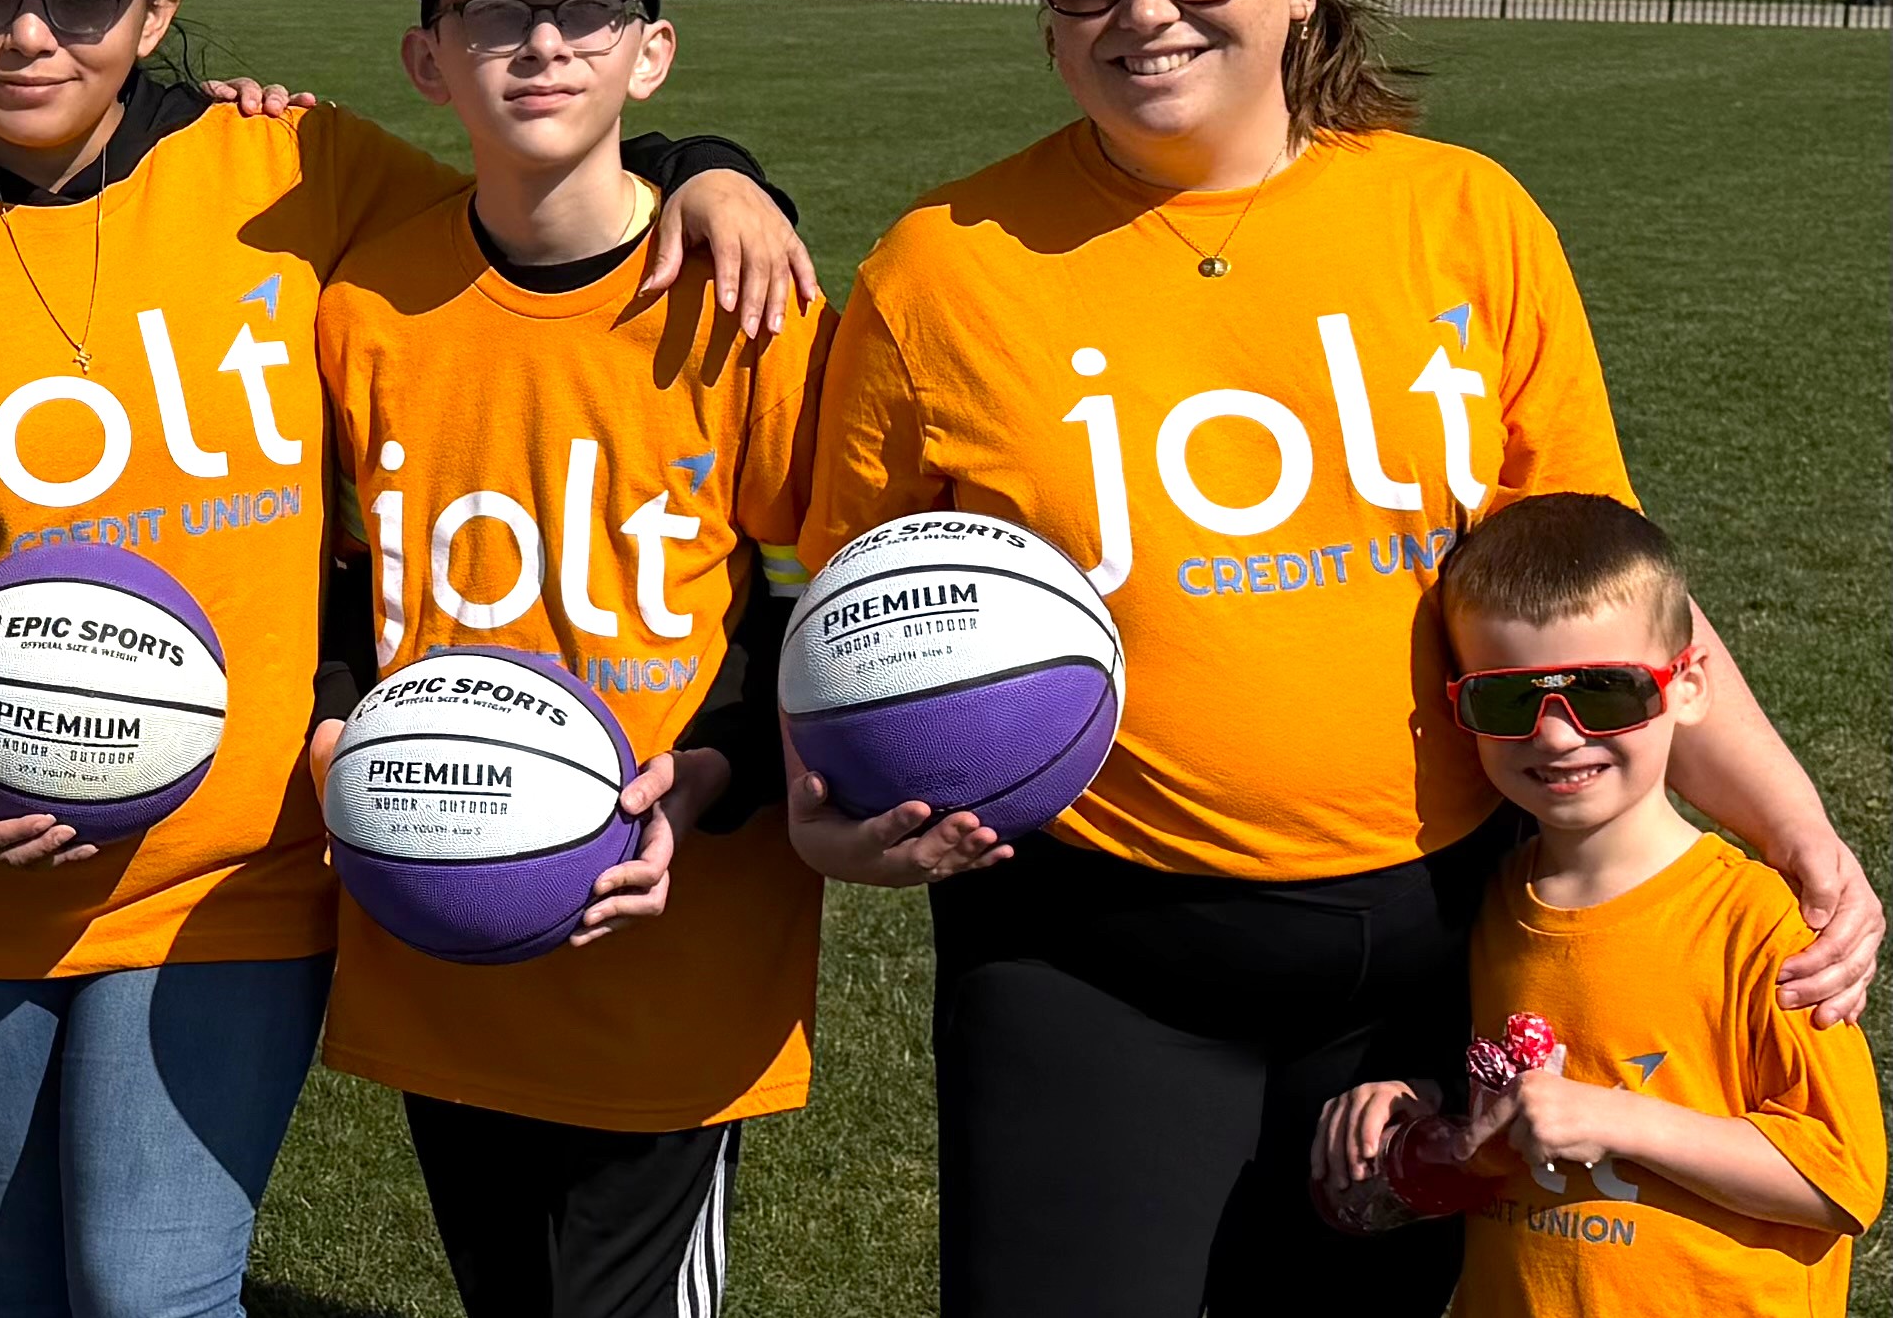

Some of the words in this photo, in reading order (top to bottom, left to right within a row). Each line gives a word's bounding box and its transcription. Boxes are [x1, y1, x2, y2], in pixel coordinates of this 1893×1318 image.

[1062, 313, 1486, 596] jolt
[181, 484, 301, 536] UNION
[898, 521, 1027, 549] SPORTS
[371, 438, 701, 668] jolt
[1177, 543, 1354, 597] CREDIT
[823, 583, 978, 636] PREMIUM
[904, 618, 977, 638] OUTDOOR
[5, 617, 72, 638] EPIC
[78, 620, 184, 667] SPORTS
[383, 677, 446, 703] EPIC
[451, 678, 568, 727] SPORTS
[70, 750, 135, 764] OUTDOOR
[368, 760, 512, 788] PREMIUM
[439, 800, 508, 815] OUTDOOR
[1528, 1203, 1635, 1247] UNION
